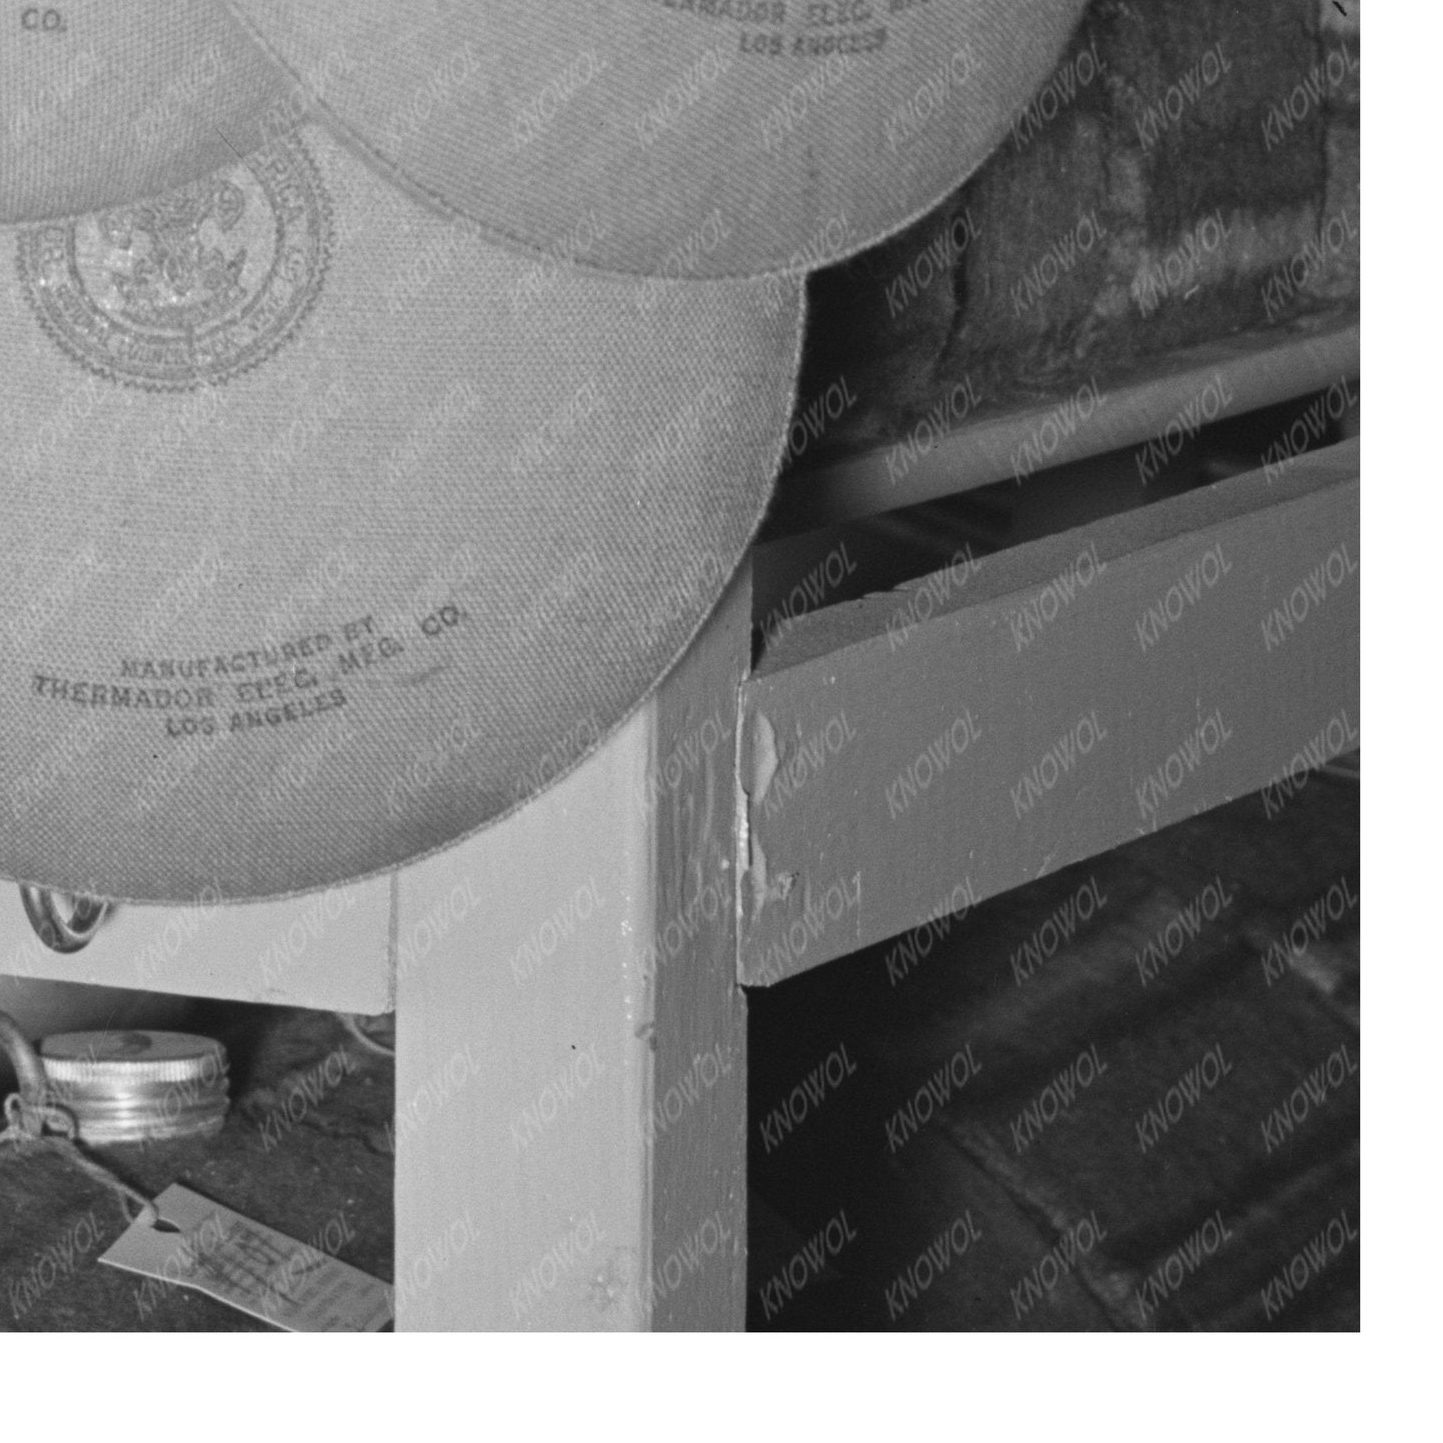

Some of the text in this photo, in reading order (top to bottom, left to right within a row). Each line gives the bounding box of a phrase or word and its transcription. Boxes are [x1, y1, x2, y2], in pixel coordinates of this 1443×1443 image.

[21, 6, 69, 35] CO.
[31, 674, 215, 709] THERMADOR
[420, 602, 469, 639] CO.
[119, 614, 377, 680] MANUFACTURED BY
[165, 688, 349, 739] LOS ANGELES
